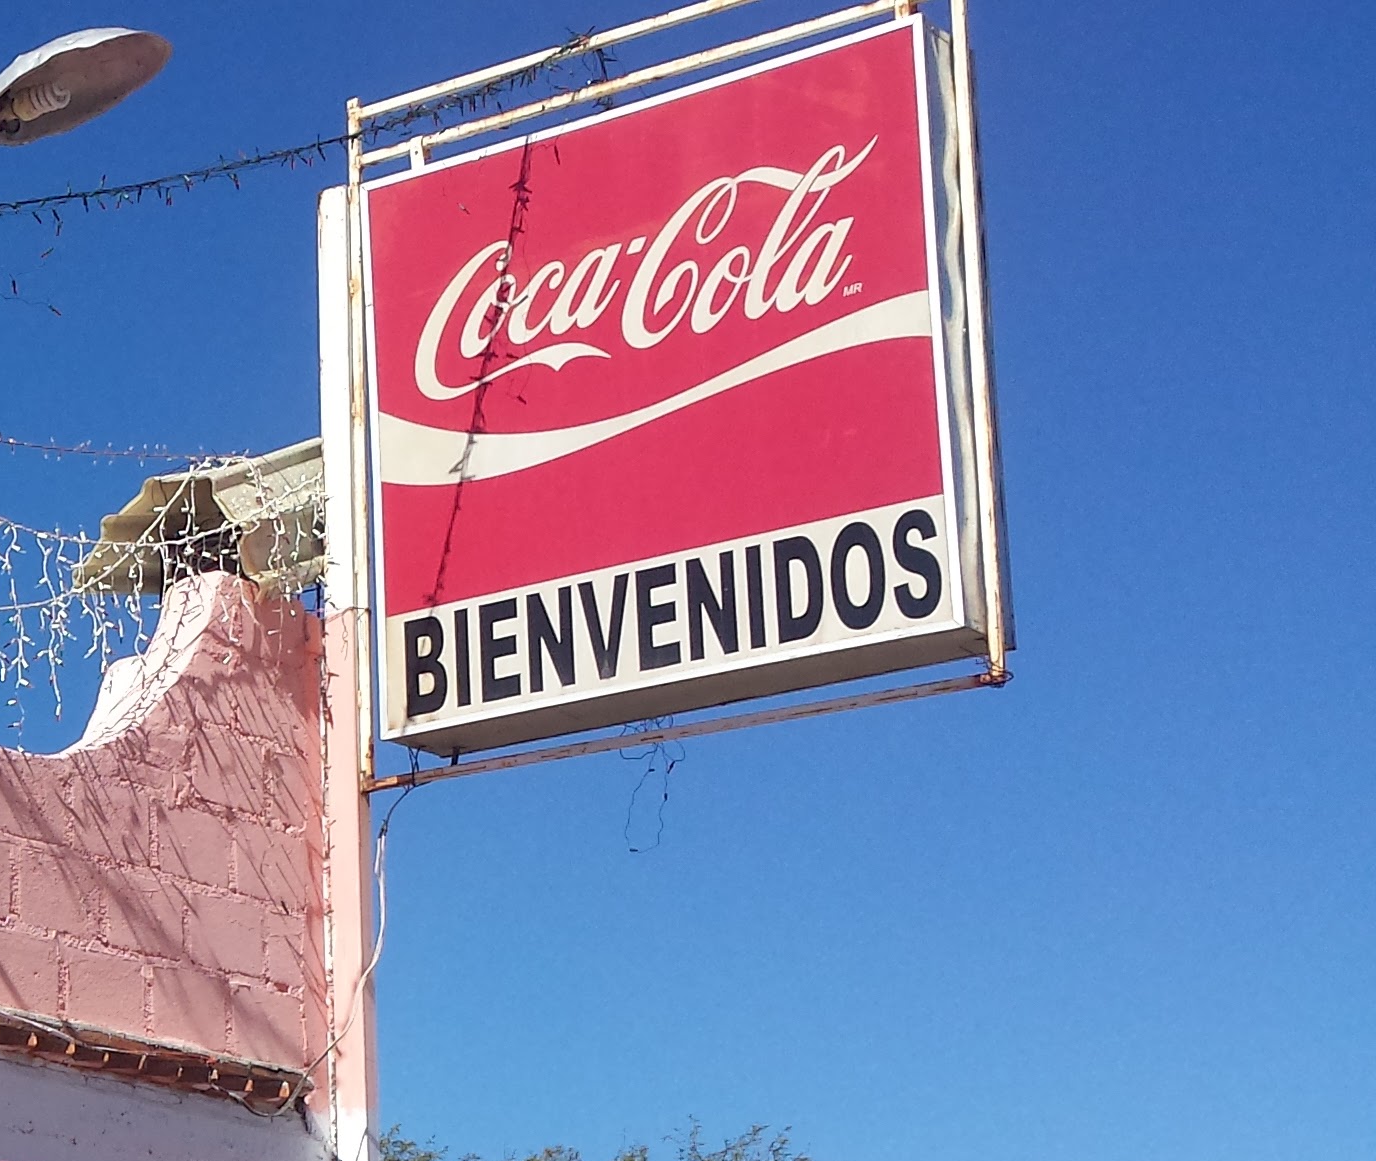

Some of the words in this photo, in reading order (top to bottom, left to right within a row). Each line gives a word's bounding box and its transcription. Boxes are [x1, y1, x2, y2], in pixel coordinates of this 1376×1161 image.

[414, 133, 878, 401] Coca-Cola
[842, 282, 863, 297] MR
[403, 507, 943, 718] BIENVENIDOS
